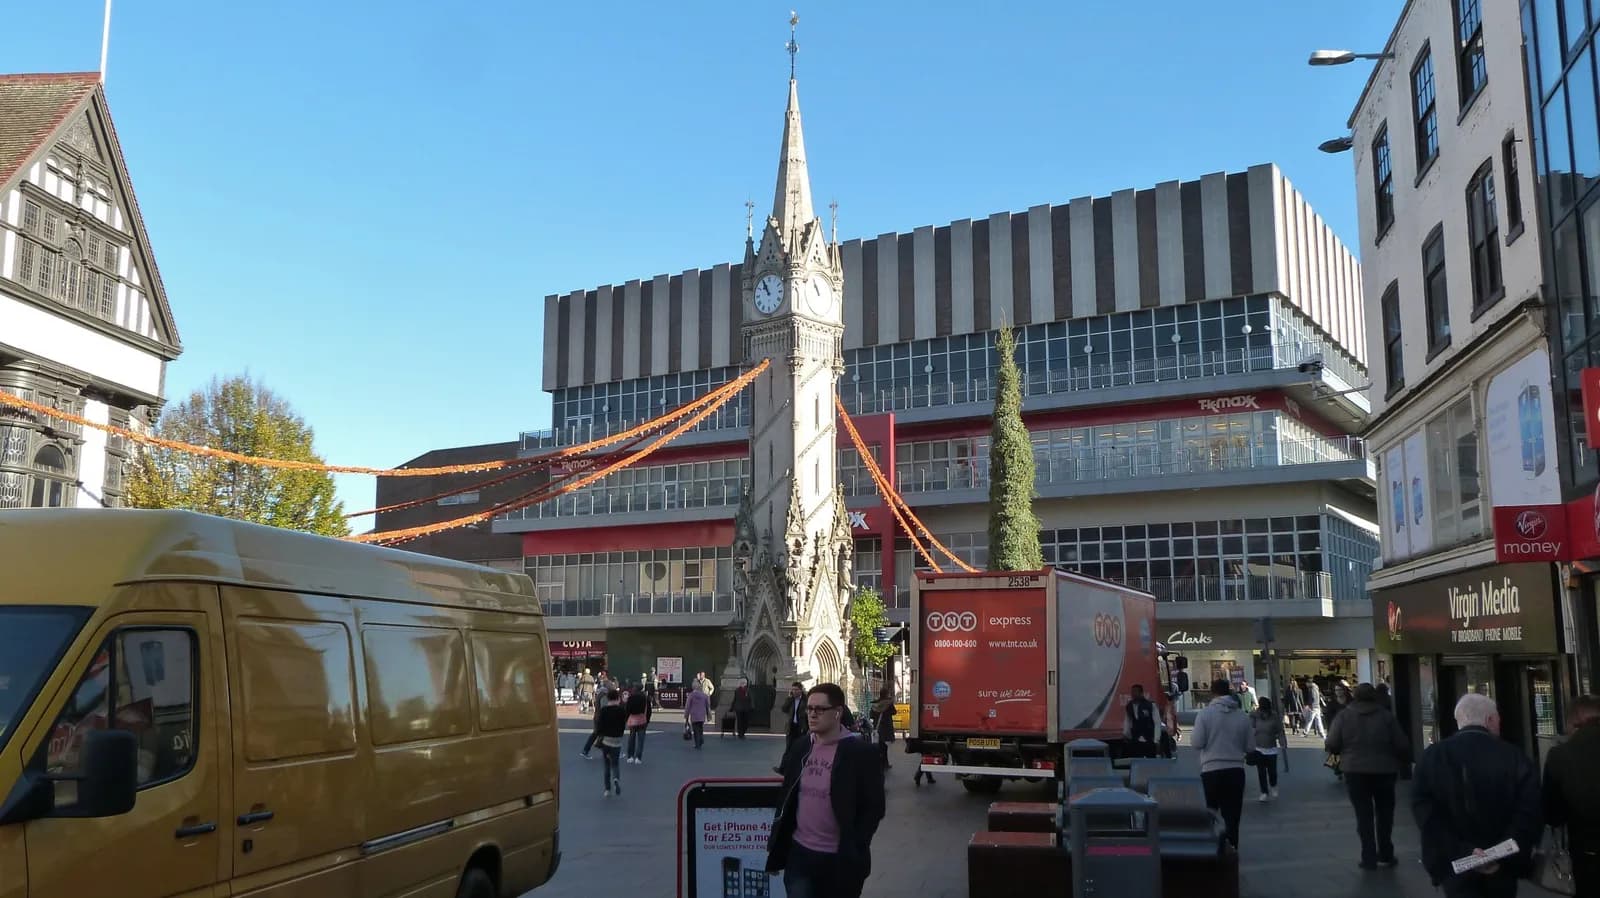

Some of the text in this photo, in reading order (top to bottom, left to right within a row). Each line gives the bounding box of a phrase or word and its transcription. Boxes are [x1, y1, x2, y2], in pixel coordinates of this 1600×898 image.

[1518, 513, 1544, 535] Virgin
[1504, 542, 1561, 557] money
[1008, 576, 1031, 587] 2538
[1448, 585, 1479, 628] Virgin
[1482, 576, 1520, 616] Media
[929, 613, 1031, 629] TNT express
[1168, 631, 1212, 644] Clarks
[1485, 628, 1501, 641] PHONE
[1502, 626, 1522, 641] MOBILE
[562, 640, 592, 648] COSTA
[934, 639, 1038, 648] 0800-100-600 www.tnt.co.uk
[977, 689, 998, 698] sure
[704, 822, 722, 832] Get
[724, 821, 758, 832] iPhone
[704, 832, 718, 842] for
[721, 832, 741, 842] £25
[745, 834, 752, 842] a
